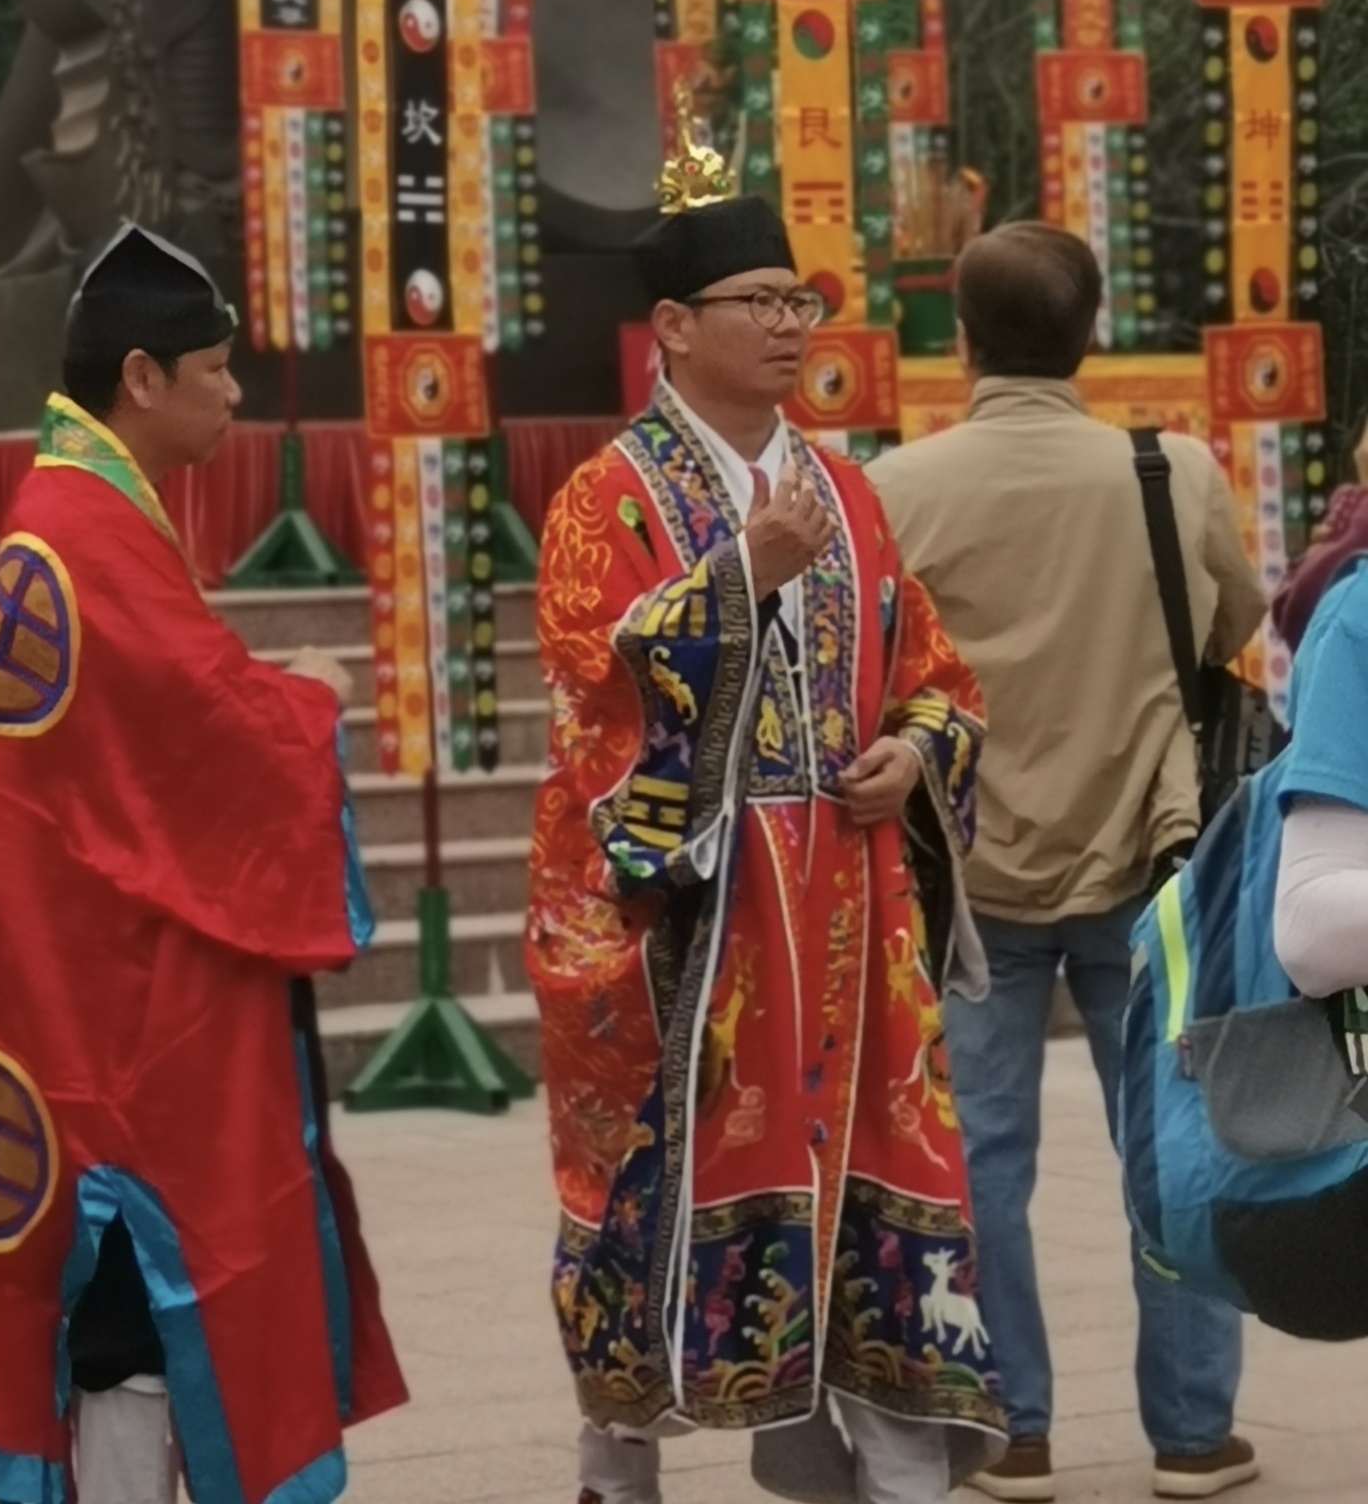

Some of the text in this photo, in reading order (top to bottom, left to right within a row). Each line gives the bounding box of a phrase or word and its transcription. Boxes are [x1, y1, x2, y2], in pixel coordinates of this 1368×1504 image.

[401, 98, 442, 146] 坎
[799, 107, 842, 149] 艮
[1244, 108, 1283, 151] 坤
